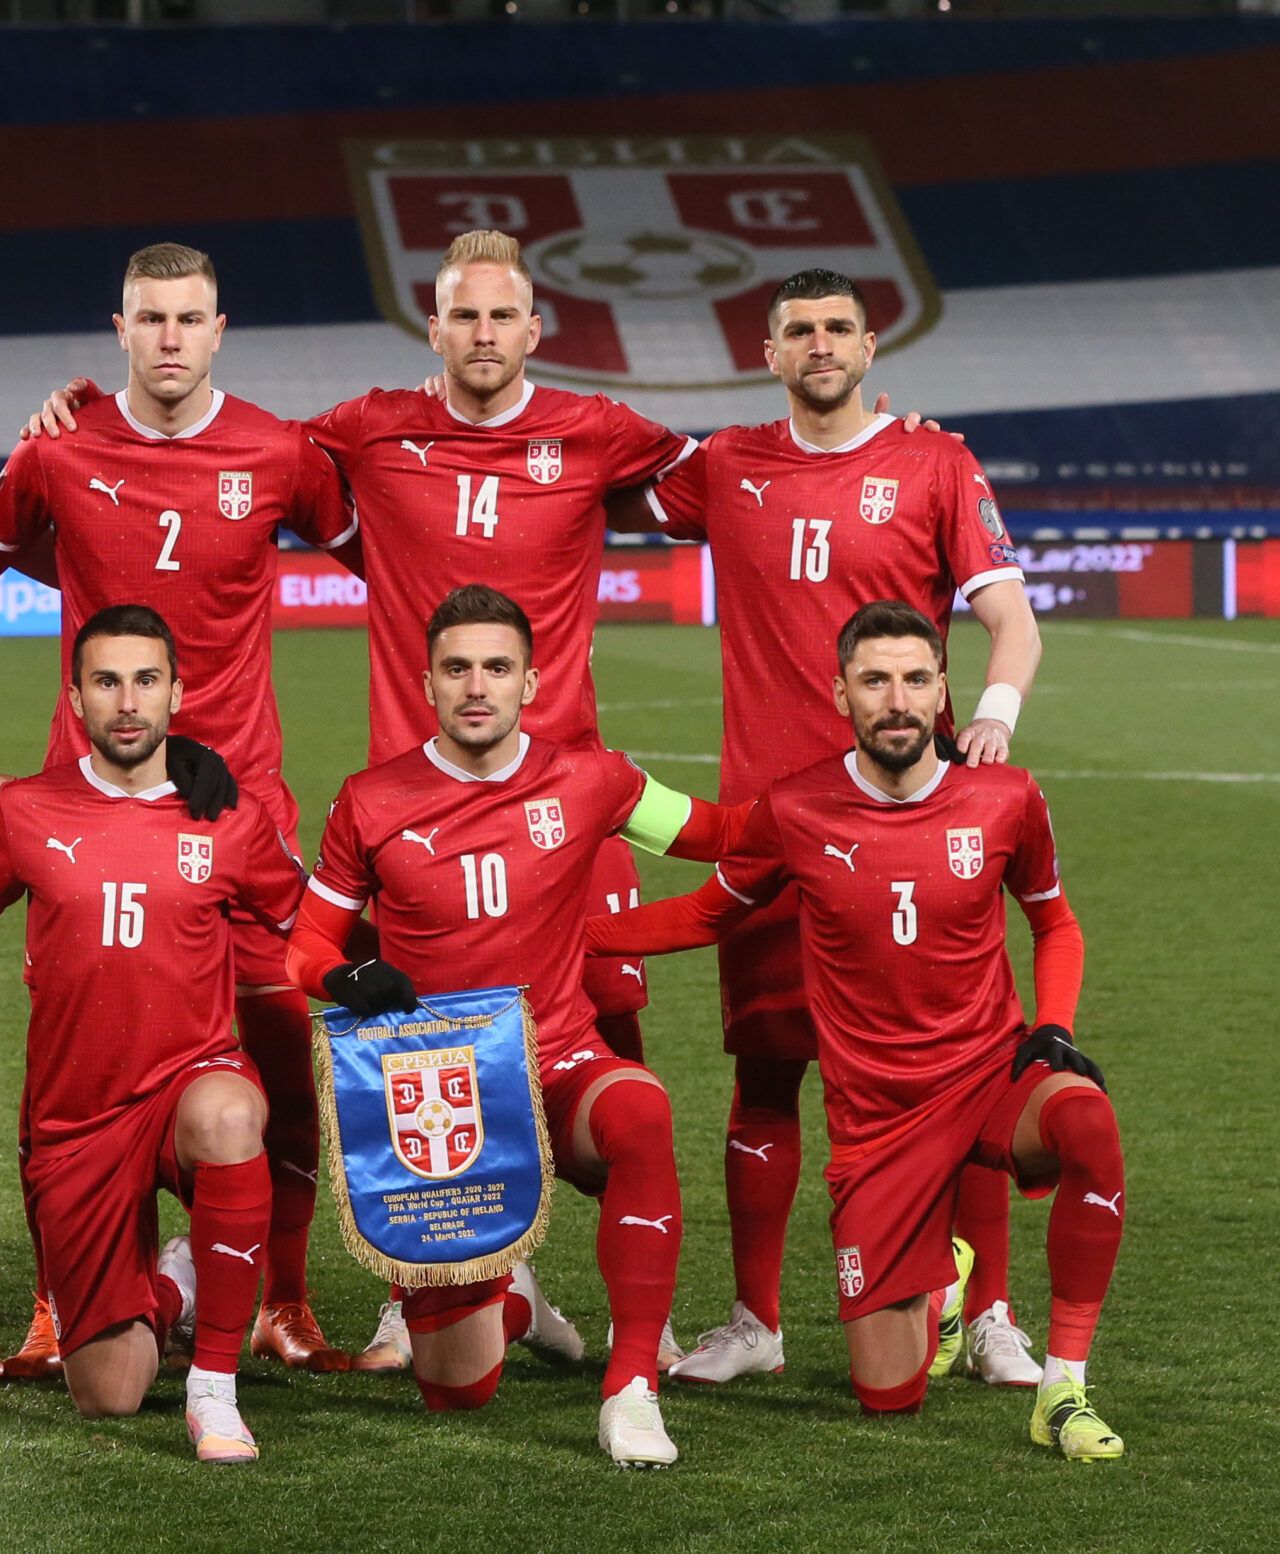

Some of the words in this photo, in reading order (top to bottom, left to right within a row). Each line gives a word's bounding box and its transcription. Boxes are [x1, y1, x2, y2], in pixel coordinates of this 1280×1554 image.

[455, 474, 500, 538] 14
[155, 510, 182, 571] 2
[790, 518, 833, 583] 13
[280, 575, 366, 606] EURO
[460, 853, 508, 919] 10
[102, 882, 147, 948] 15
[891, 881, 917, 945] 3
[357, 1026, 397, 1040] FOOTBALL
[399, 1020, 449, 1037] ASSOCIATION
[387, 1050, 469, 1070] СРБИЈА
[383, 1192, 420, 1204] EUROPEAN
[421, 1187, 462, 1200] QUALIFIERS
[487, 1183, 505, 1192] 2022
[388, 1203, 405, 1212] FIFA
[407, 1200, 428, 1211] World
[483, 1192, 501, 1201] 2022
[389, 1213, 417, 1225] SERBIA
[423, 1209, 458, 1221] REPUBLIC
[460, 1207, 470, 1216] OF
[472, 1204, 504, 1215] IRELAND
[435, 1231, 456, 1242] March
[457, 1229, 476, 1239] 2021
